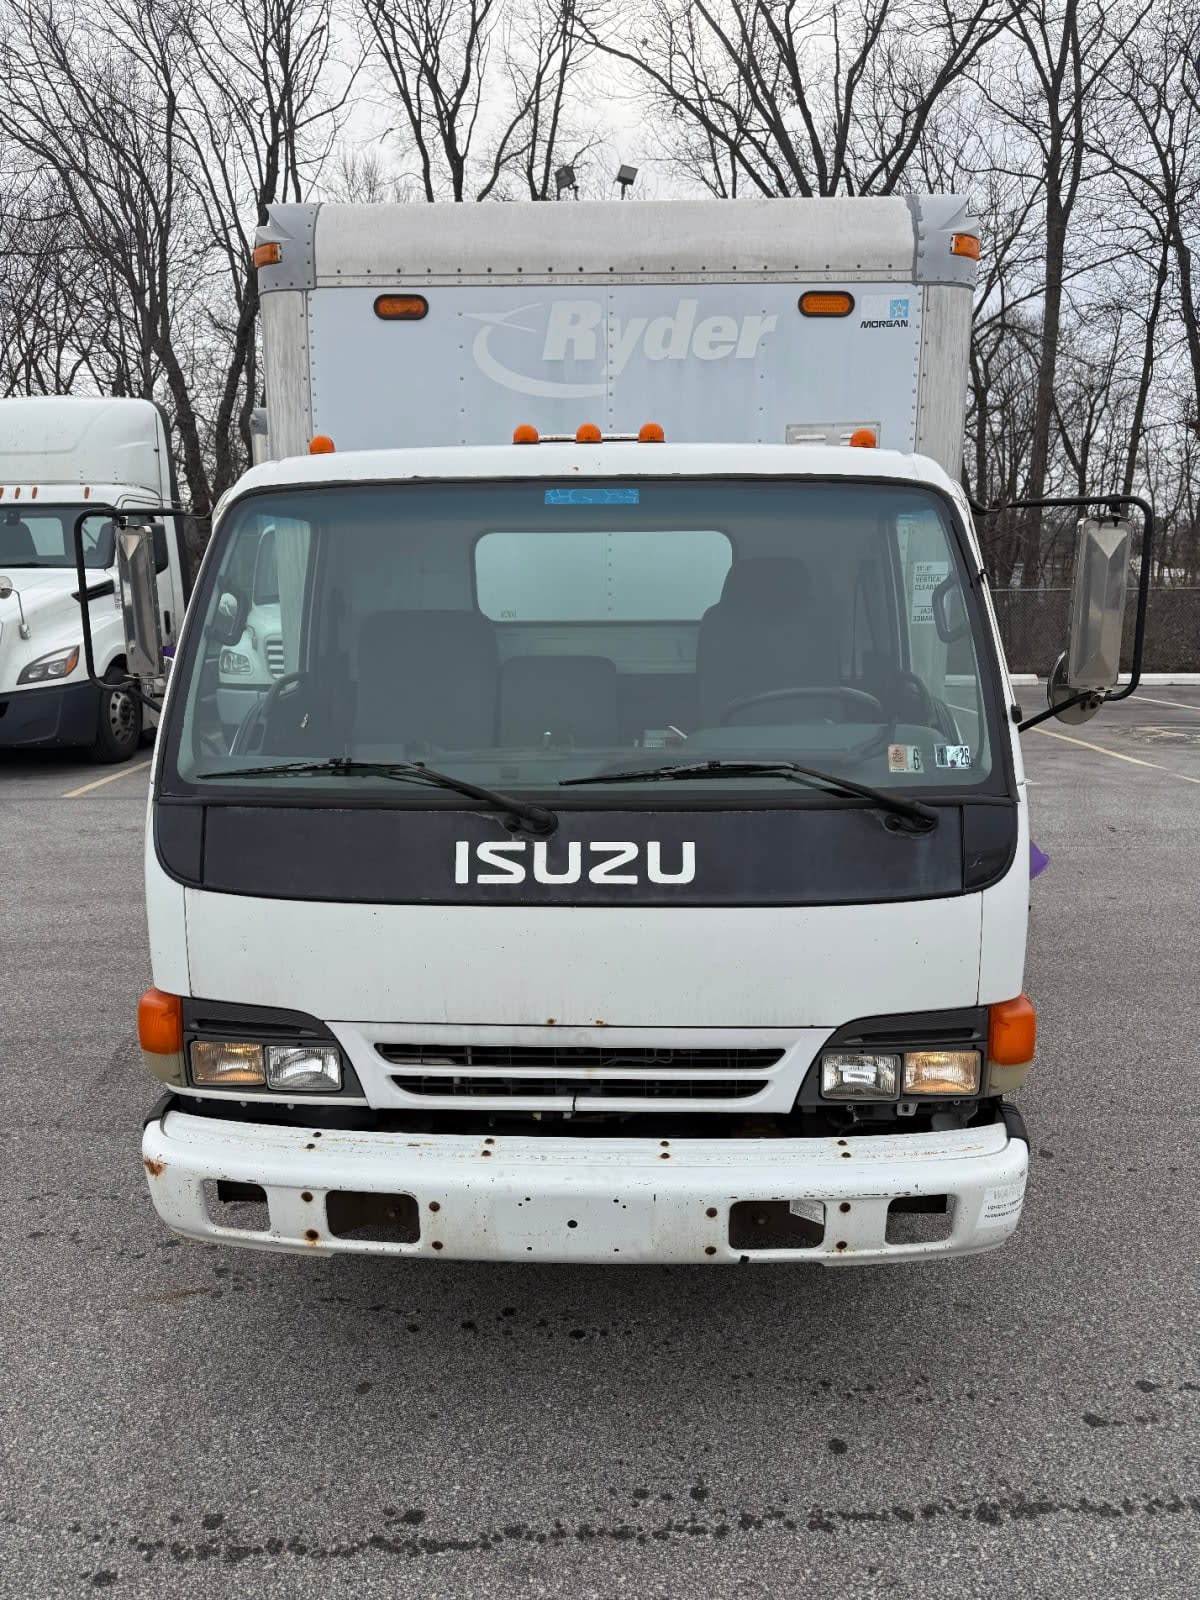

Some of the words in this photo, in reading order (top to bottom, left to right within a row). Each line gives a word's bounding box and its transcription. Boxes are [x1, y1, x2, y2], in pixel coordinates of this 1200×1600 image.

[543, 299, 778, 375] Ryder
[860, 319, 909, 328] MORGAN
[959, 747, 970, 766] 26
[455, 841, 696, 885] ISUZU
